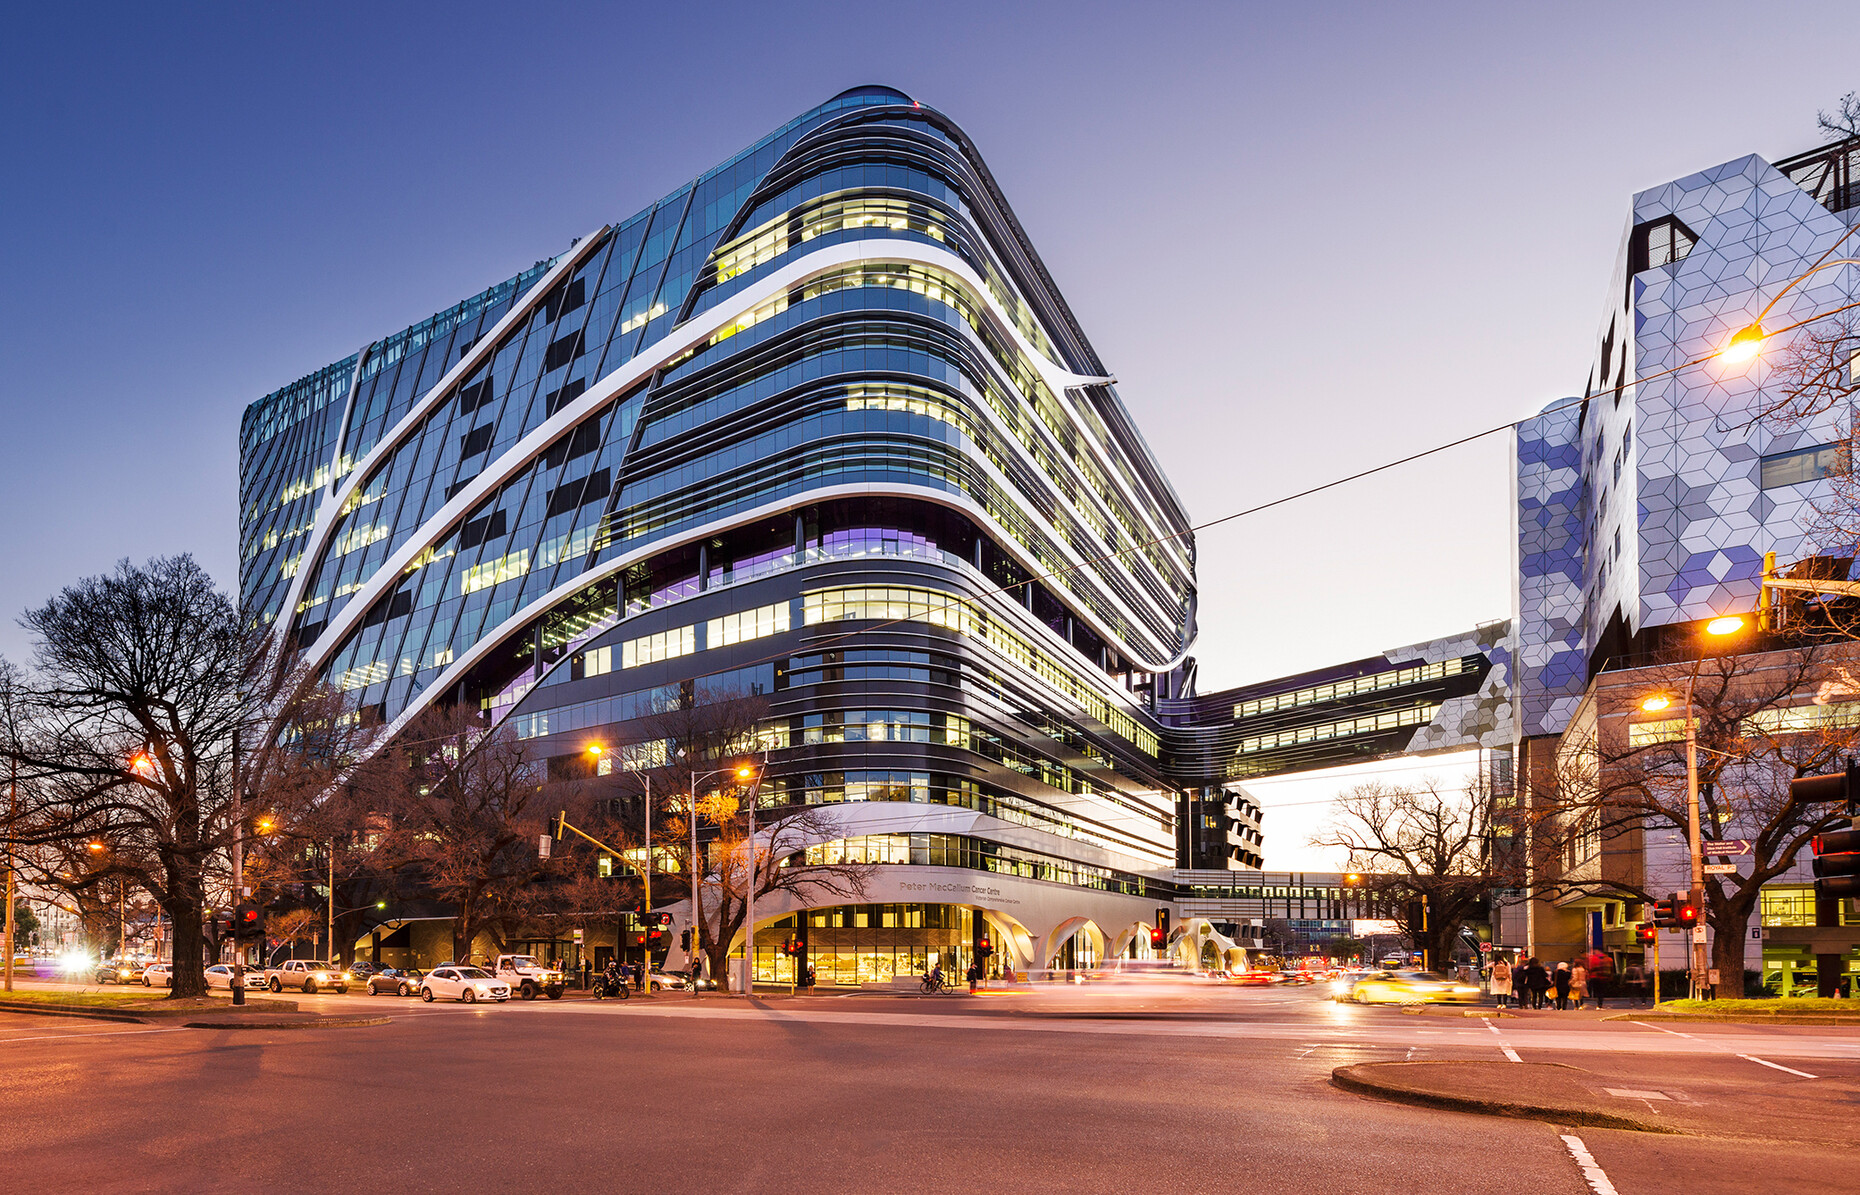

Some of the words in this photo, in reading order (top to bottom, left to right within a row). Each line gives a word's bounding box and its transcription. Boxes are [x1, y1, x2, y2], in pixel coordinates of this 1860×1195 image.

[900, 881, 927, 892] Peter
[929, 882, 971, 893] MacCallum
[971, 885, 987, 894] Cancer
[987, 887, 1000, 895] Centre
